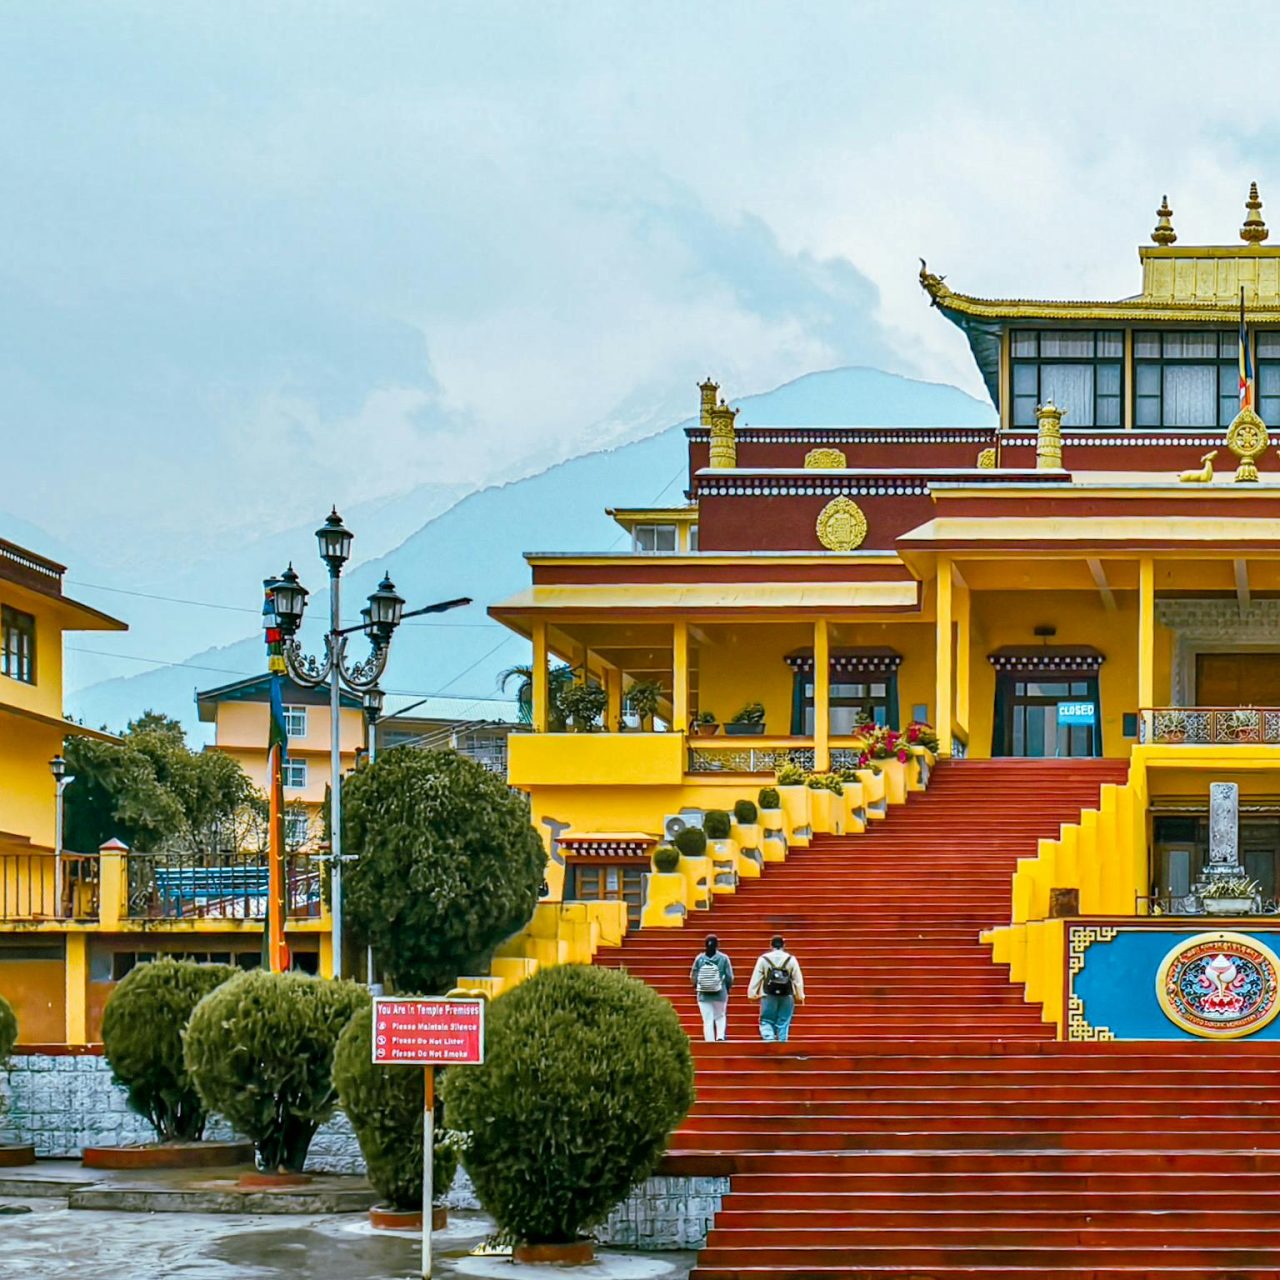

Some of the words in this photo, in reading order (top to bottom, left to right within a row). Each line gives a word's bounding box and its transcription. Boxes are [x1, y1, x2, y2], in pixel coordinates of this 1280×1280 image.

[1059, 704, 1094, 716] CLOSED
[377, 1004, 391, 1015] You
[393, 1004, 406, 1015] Are
[407, 1004, 415, 1015] In
[417, 1004, 443, 1016] Temple
[445, 1005, 480, 1015] Premises
[418, 1023, 448, 1031] Maintain
[450, 1023, 477, 1031] Silence
[418, 1037, 427, 1045] Do
[429, 1037, 442, 1045] Not
[444, 1037, 464, 1045] Litter
[392, 1049, 415, 1057] Please
[418, 1049, 427, 1057] Do
[429, 1049, 442, 1057] Not
[444, 1049, 468, 1058] Smoke
